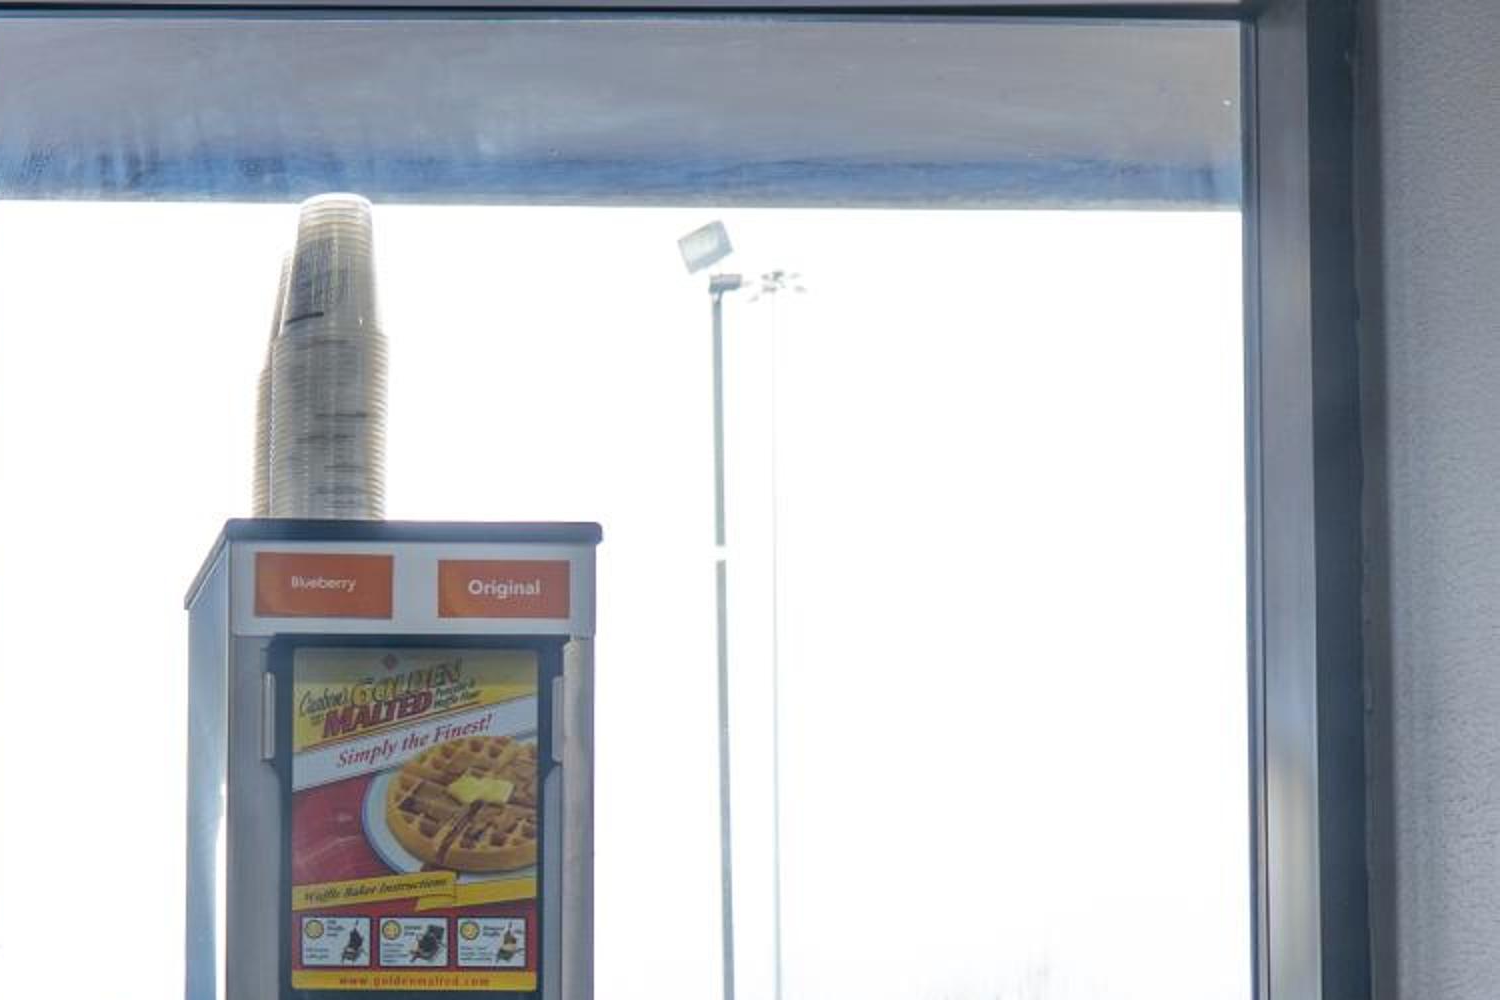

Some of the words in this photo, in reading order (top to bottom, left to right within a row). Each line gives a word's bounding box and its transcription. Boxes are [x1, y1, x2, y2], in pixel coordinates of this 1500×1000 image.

[291, 575, 357, 592] Blueberry
[468, 579, 541, 599] Original
[322, 691, 433, 738] MALTED
[337, 736, 398, 768] Simply
[402, 731, 427, 752] the
[433, 713, 494, 744] Finest!
[345, 885, 377, 898] Baker
